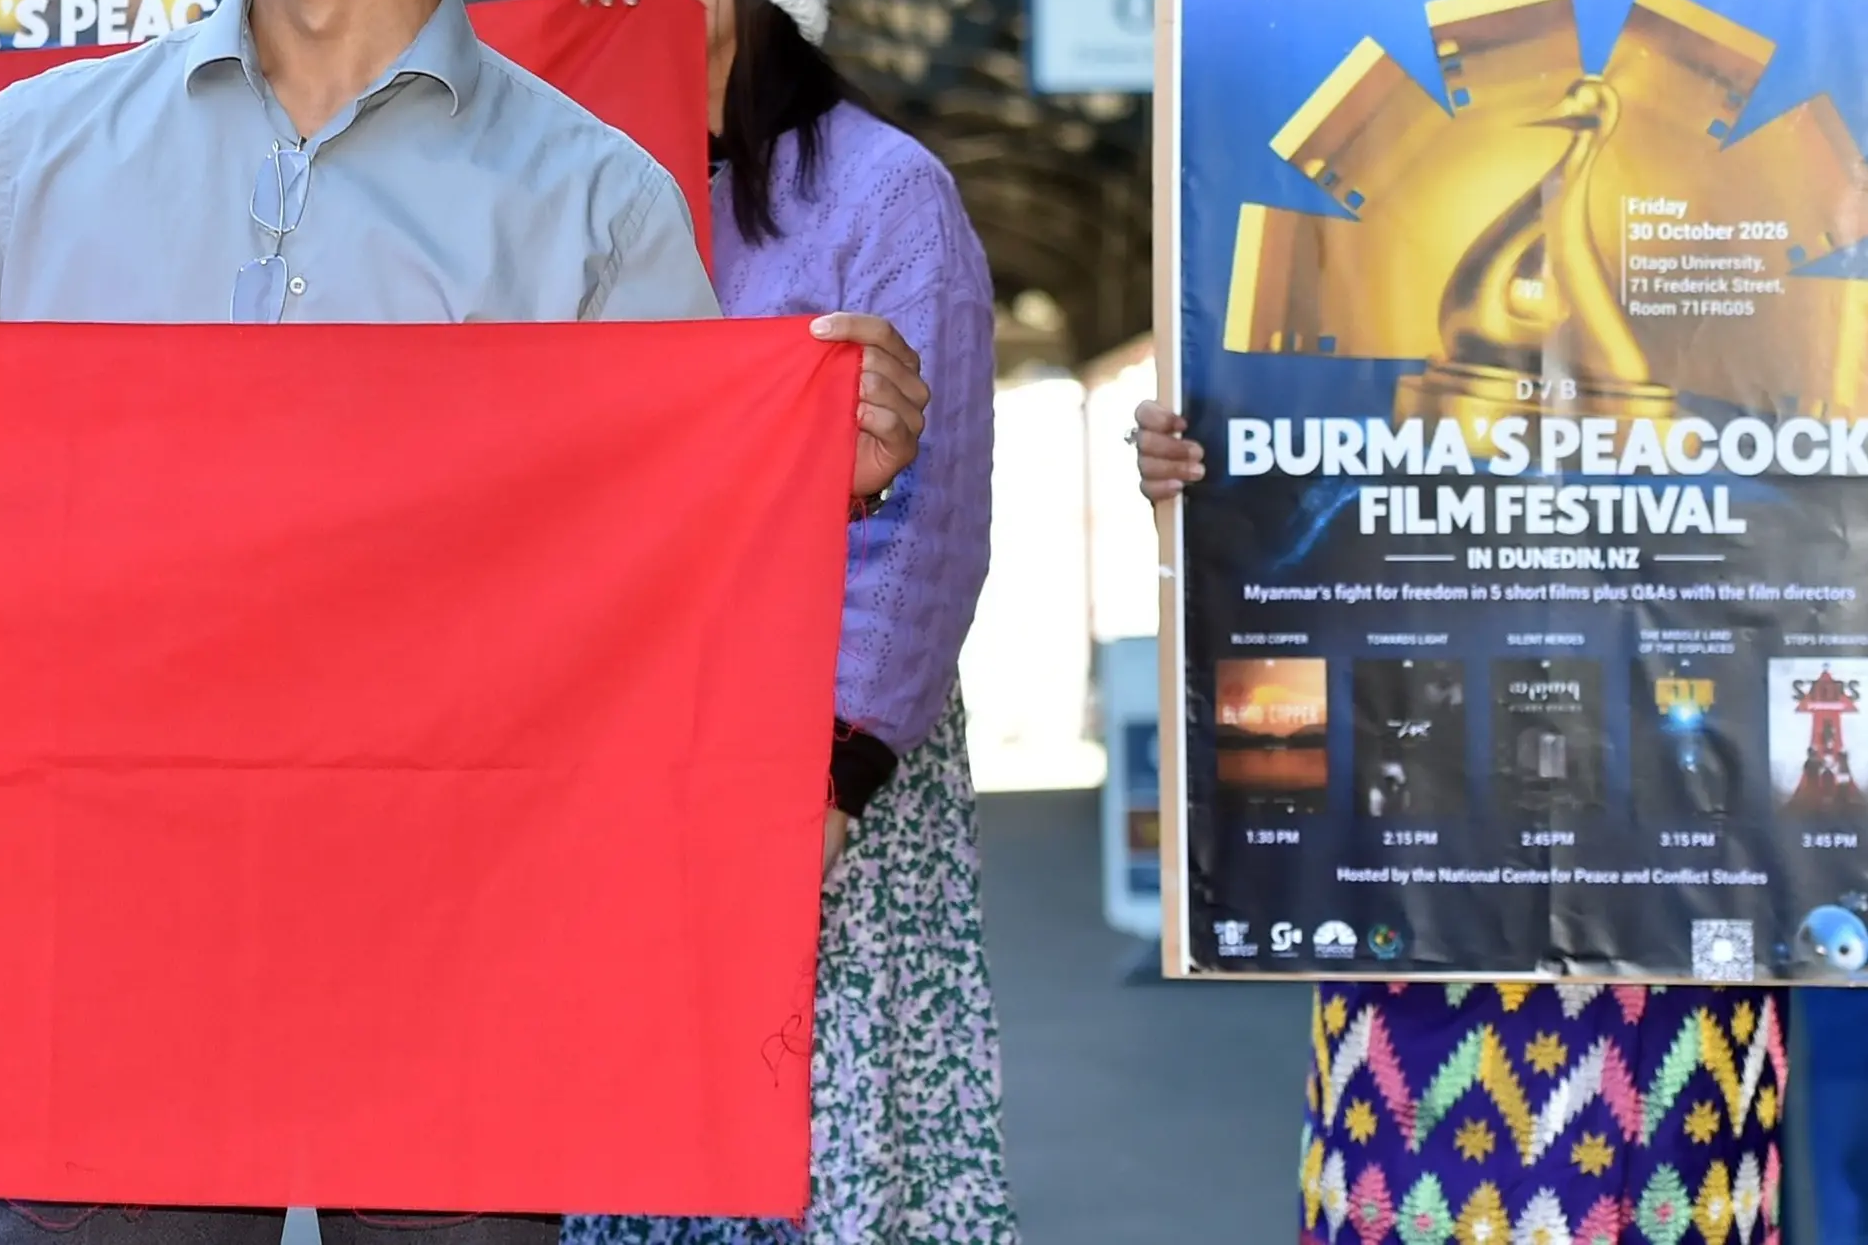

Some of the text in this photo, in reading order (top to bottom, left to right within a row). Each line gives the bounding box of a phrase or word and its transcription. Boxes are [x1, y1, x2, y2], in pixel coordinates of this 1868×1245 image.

[1627, 197, 1687, 218] Friday
[1628, 221, 1789, 241] 30 October 2026
[1629, 255, 1678, 274] Otago
[1629, 278, 1648, 293] 71
[1653, 277, 1728, 294] Frederick
[1629, 300, 1677, 316] Room
[1228, 417, 1868, 477] BURMA'S PEACOCK
[1360, 485, 1747, 535] FILM FESTIVAL
[1467, 547, 1641, 571] IN DUNEDIN, NZ
[1243, 583, 1856, 604] Myanmar's fight for freedom in 5 short films plus Q&As with the film directors
[1276, 830, 1300, 845] PM
[1414, 831, 1439, 846] PM
[1551, 832, 1575, 847] PM
[1692, 832, 1716, 847] PM
[1834, 834, 1858, 849] PM
[1336, 867, 1769, 885] Hosted by the National Centre for Peace and Conflict Studies
